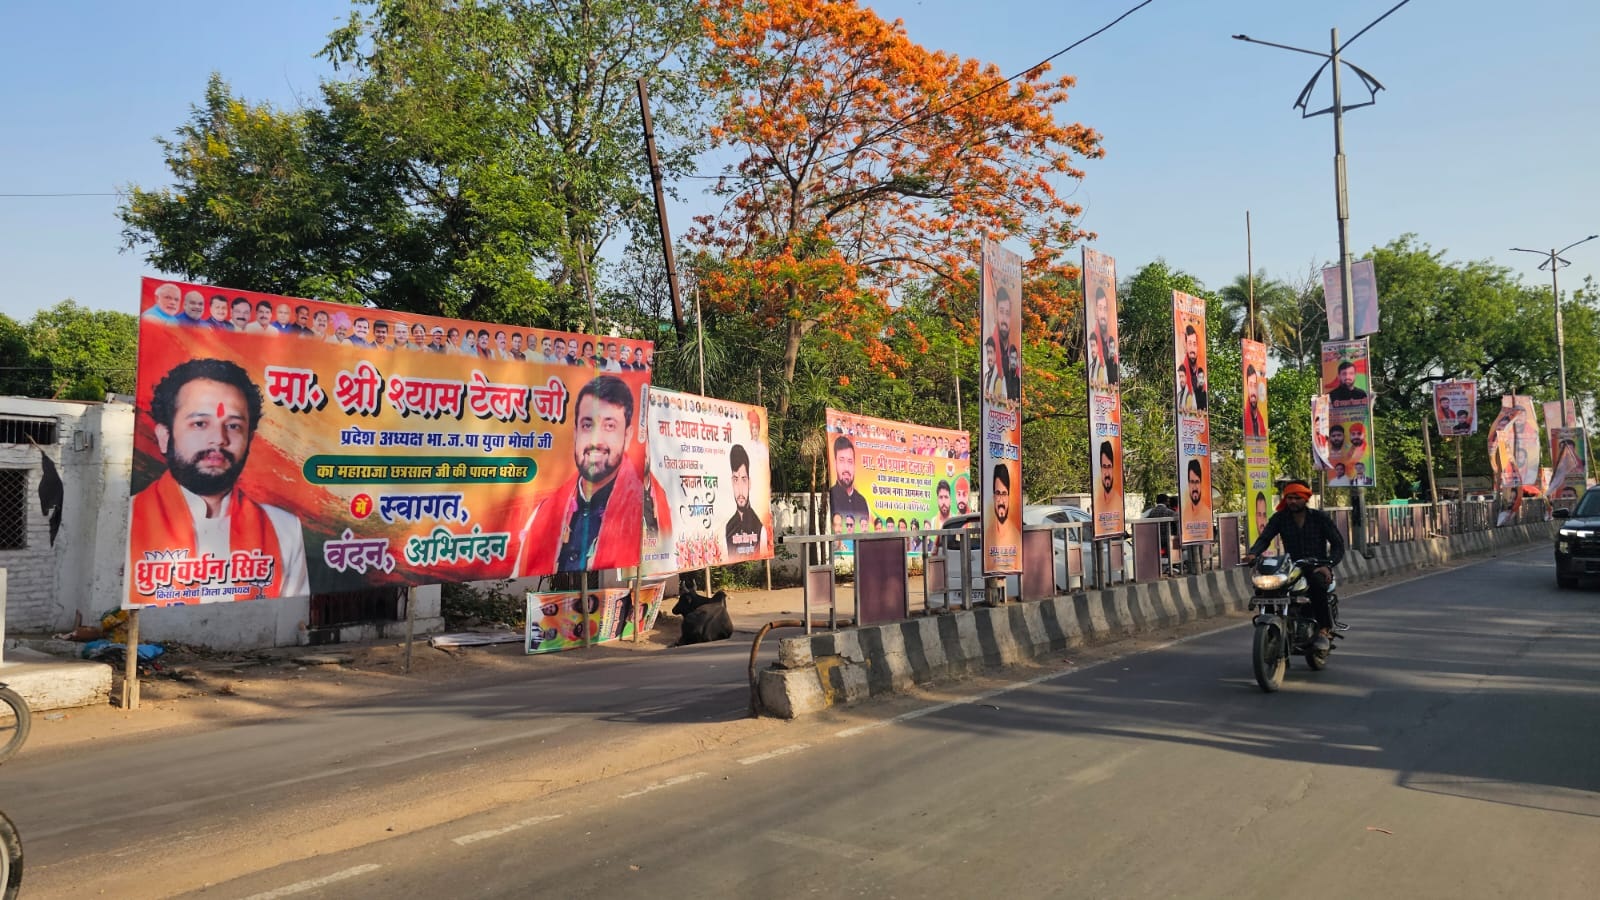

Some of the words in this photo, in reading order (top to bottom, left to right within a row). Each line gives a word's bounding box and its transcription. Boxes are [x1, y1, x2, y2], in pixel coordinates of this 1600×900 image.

[266, 367, 325, 408] मा.
[335, 361, 382, 412] श्री
[386, 375, 463, 416] श्याम
[467, 369, 528, 420] टेलर
[531, 376, 567, 421] जी
[340, 427, 376, 446] प्रदेश
[379, 430, 423, 447] अध्यक्ष
[482, 434, 505, 452] युवा
[507, 432, 535, 449] मोर्चा
[537, 433, 553, 449] जी
[675, 420, 699, 440] श्याम
[700, 418, 719, 442] टेलर
[721, 422, 732, 443] जी
[316, 464, 335, 478] का
[337, 464, 388, 479] महाराजा
[390, 464, 432, 479] छत्रसाल
[435, 463, 450, 479] जी
[452, 463, 468, 478] की
[469, 465, 498, 478] पावन
[499, 463, 528, 478] धरोहर
[355, 497, 370, 515] में
[379, 494, 470, 523] स्वागत,
[324, 528, 395, 574] वंदन,
[405, 524, 510, 566] अभिनंदन
[136, 559, 173, 594] ध्रुव
[176, 554, 229, 586] वर्धन
[231, 550, 274, 583] सिंह
